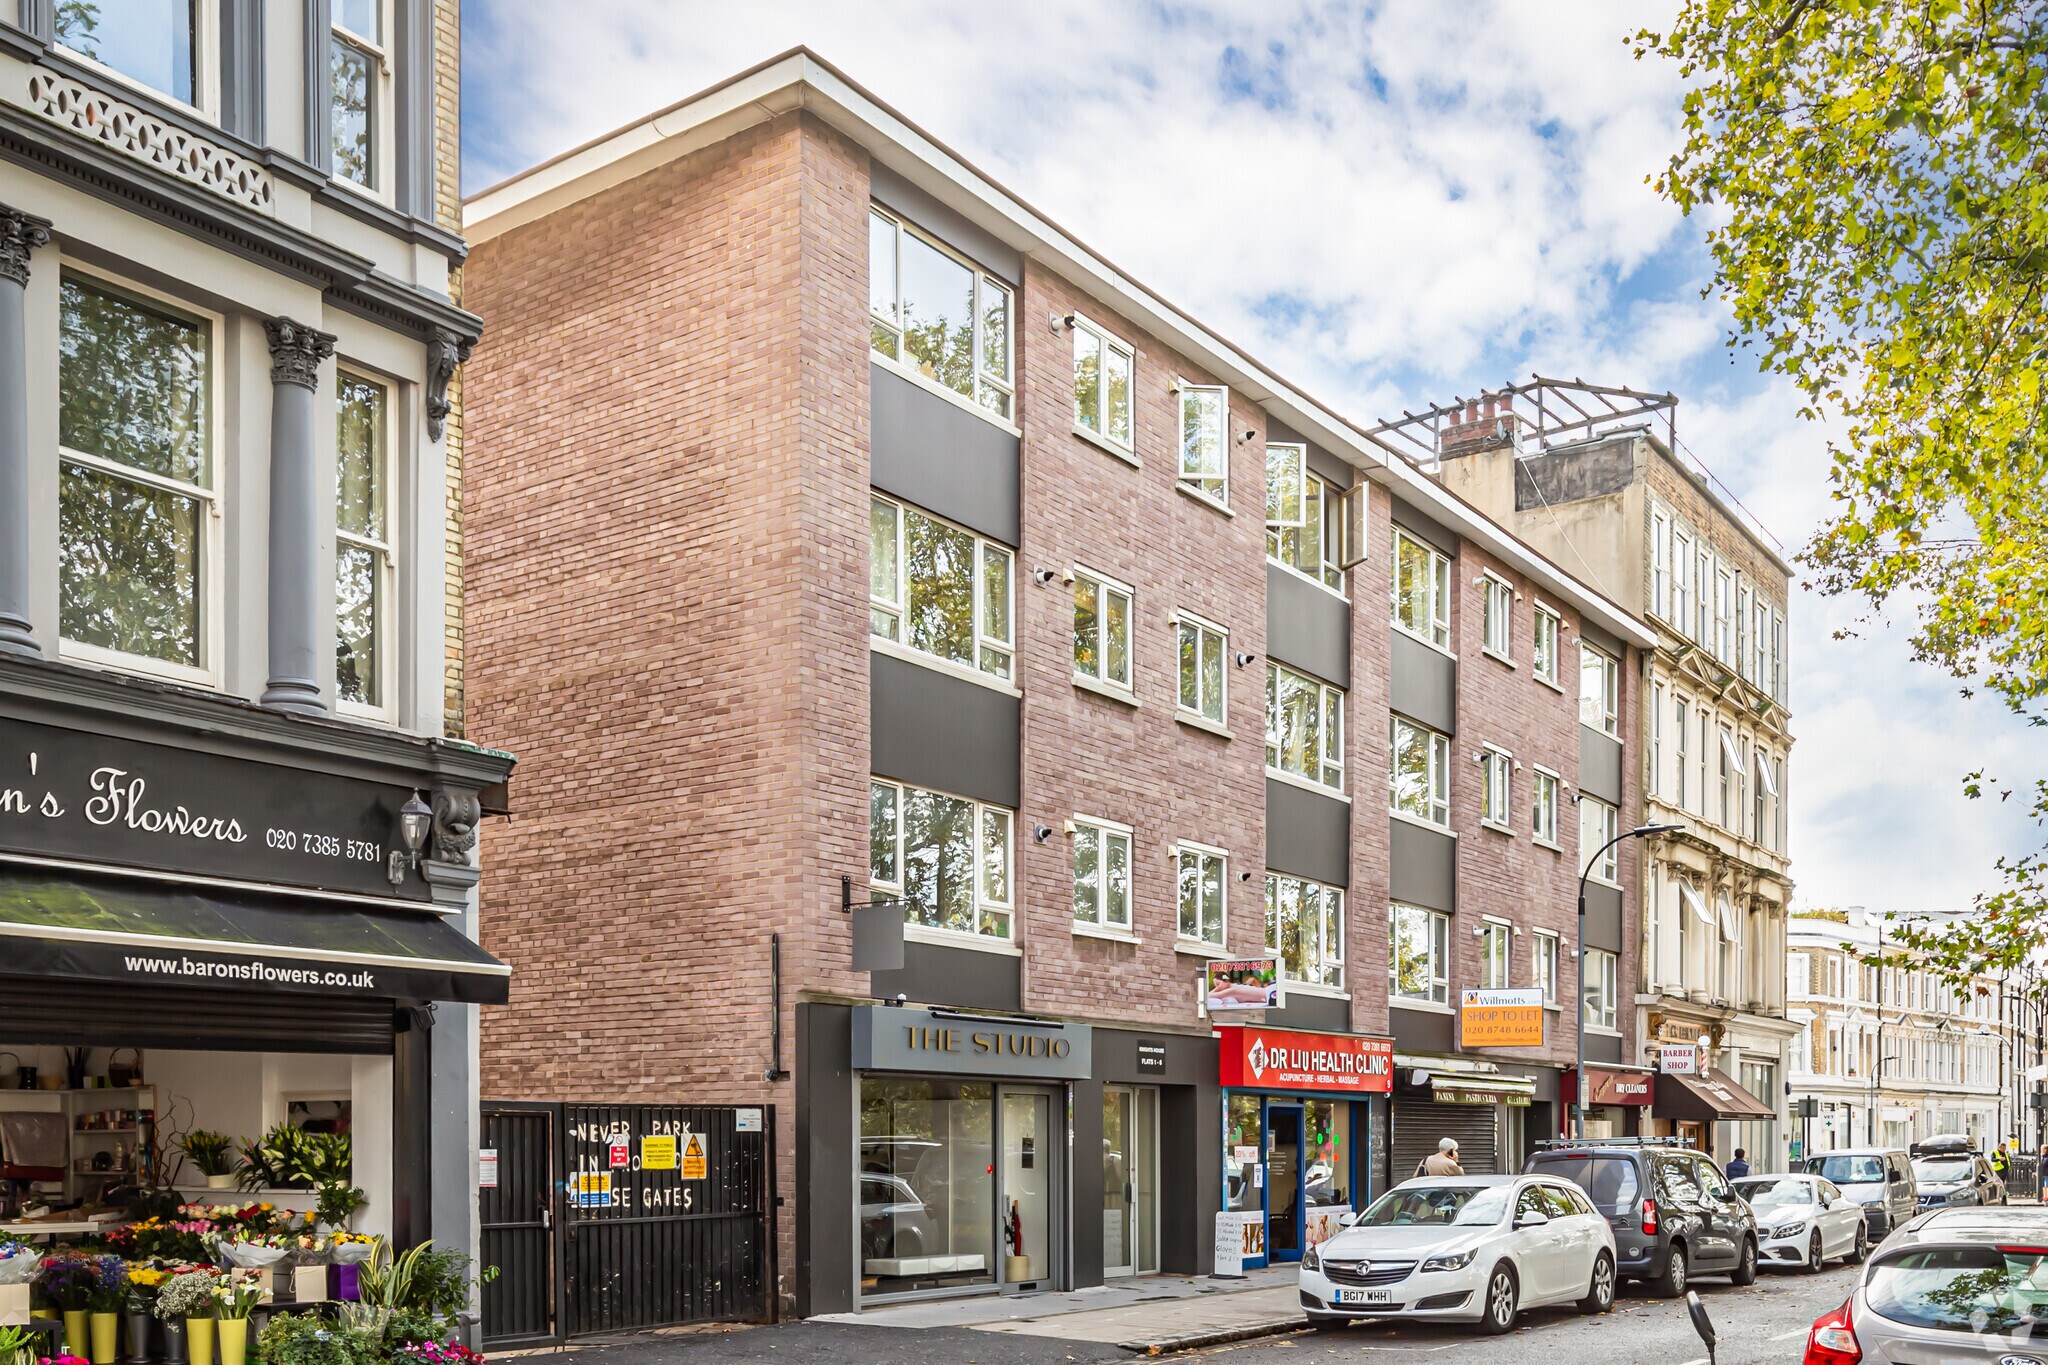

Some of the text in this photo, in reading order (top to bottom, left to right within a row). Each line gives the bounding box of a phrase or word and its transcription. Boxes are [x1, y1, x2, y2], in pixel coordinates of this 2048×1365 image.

[85, 767, 247, 842] Flowers
[266, 828, 380, 862] 020 7385 5781
[125, 956, 374, 988] www.baronsflowers.co.uk
[1467, 1010, 1539, 1021] SHOP TO LET
[1465, 1025, 1539, 1034] 020 8748 6644
[903, 1026, 1071, 1058] THE STUDIO
[1270, 1047, 1287, 1069] DR
[1291, 1048, 1309, 1072] LIU
[1311, 1050, 1353, 1074] HEALTH
[1355, 1053, 1389, 1075] CLINIC
[1663, 1049, 1693, 1057] BARBER
[1279, 1073, 1314, 1083] ACUPUNCTURE
[1317, 1075, 1336, 1084] HERBAL
[1387, 1079, 1391, 1089] 9
[1615, 1083, 1648, 1094] DRY CLEANERS
[577, 1120, 691, 1142] NEVER PARK
[643, 1187, 692, 1208] GATES
[1343, 1291, 1387, 1301] BG17 WHH
